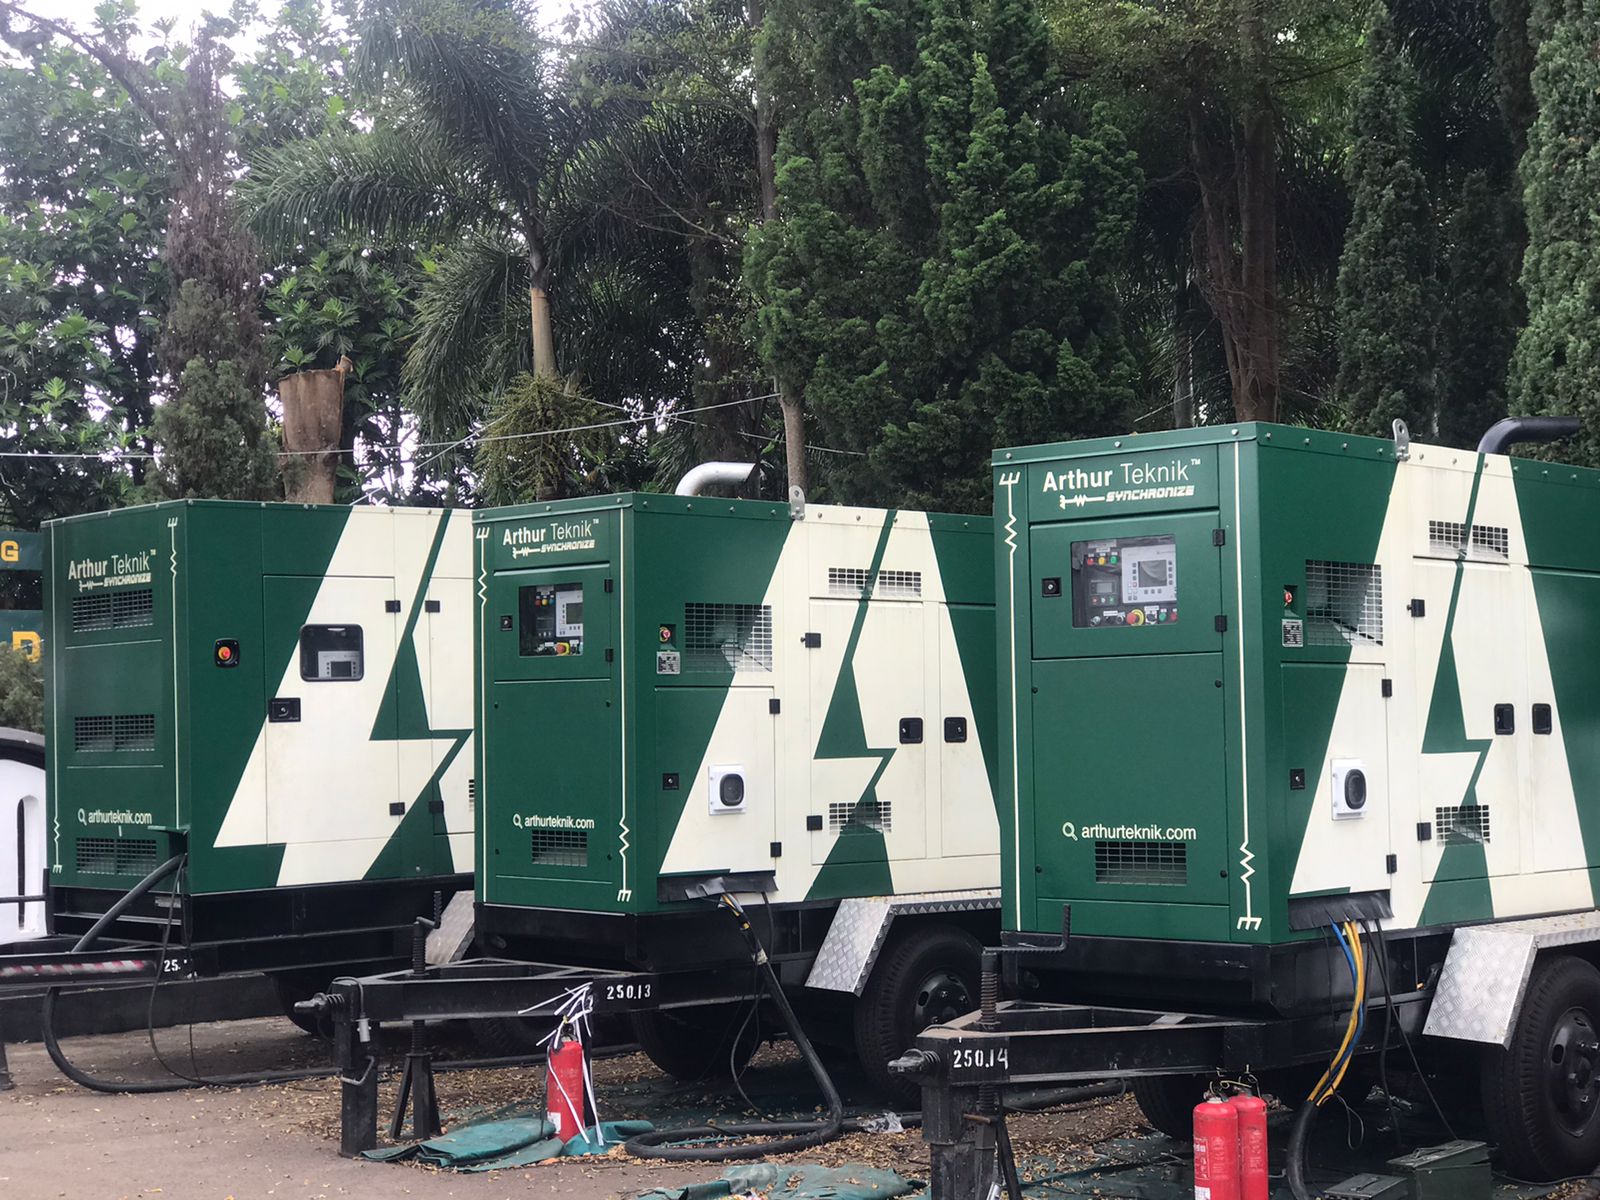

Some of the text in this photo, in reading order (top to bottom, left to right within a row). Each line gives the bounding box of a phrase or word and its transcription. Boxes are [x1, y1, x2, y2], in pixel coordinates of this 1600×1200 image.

[1043, 468, 1113, 493] Arthur
[1105, 485, 1195, 503] SYNCHRONIZE
[502, 526, 547, 546] Arthur
[540, 539, 596, 553] SYNCHRONIZE
[68, 558, 108, 580] Arthur
[103, 572, 152, 587] SYNCHRONIZE
[88, 809, 153, 825] arthurteknik.com
[524, 814, 595, 829] arthurteknik.com
[1081, 823, 1197, 840] arthurteknik.com
[606, 984, 651, 1000] 250.13
[953, 1047, 1009, 1070] 250.14
